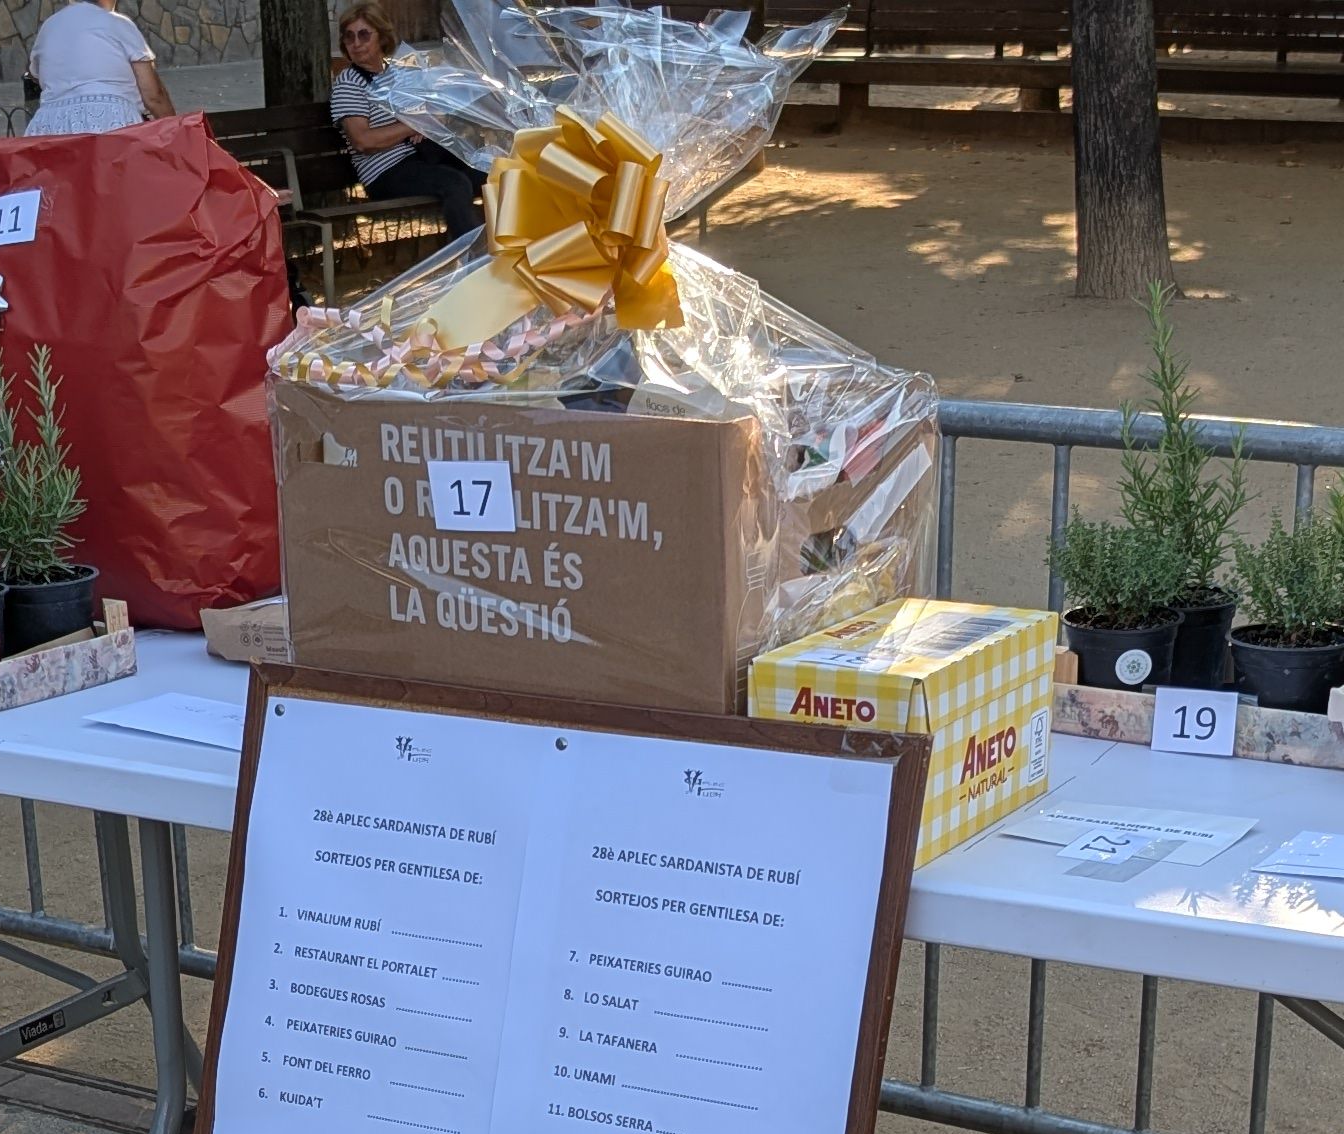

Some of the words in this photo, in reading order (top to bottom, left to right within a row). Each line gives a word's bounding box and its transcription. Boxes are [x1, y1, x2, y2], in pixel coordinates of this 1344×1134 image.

[381, 423, 611, 483] REUTILITZA'M
[384, 477, 404, 515] O
[449, 479, 492, 517] 17
[388, 533, 532, 585] AQUESTA
[544, 542, 583, 591] ÉS
[390, 585, 426, 624] LA
[436, 587, 571, 643] QÜESTIÓ
[789, 687, 876, 723] ANETO
[1172, 705, 1217, 741] 19
[960, 726, 1017, 785] ANETO
[967, 773, 1007, 803] NATURAL
[313, 808, 333, 823] 28è
[336, 812, 370, 829] APLEC
[373, 816, 446, 839] SARDANISTA
[450, 827, 465, 841] DE
[468, 829, 496, 846] RUBÍ
[315, 849, 371, 869] SORTEJOS
[374, 858, 395, 873] PER
[399, 861, 460, 883] GENTILESA
[464, 870, 483, 885] DE:
[592, 845, 614, 861] 28è
[617, 849, 657, 867] APLEC
[660, 855, 743, 879] SARDANISTA
[747, 866, 764, 882] DE
[768, 869, 801, 886] RUBÍ
[279, 906, 287, 918] 1.
[297, 908, 351, 928] VINALIUM
[354, 917, 381, 933] RUBÍ
[595, 888, 658, 910] SORTEJOS
[662, 898, 686, 914] PER
[689, 902, 759, 925] GENTILESA
[763, 912, 785, 928] DE:
[274, 942, 283, 955] 2.
[295, 945, 364, 968] RESTAURANT
[367, 957, 378, 970] EL
[382, 959, 437, 979] PORTALET
[570, 949, 578, 963] 7.
[589, 953, 661, 976] PEIXATERIES
[664, 964, 712, 983] GUIRAO
[269, 978, 278, 991] 3.
[291, 982, 348, 1002] BODEGUES
[351, 992, 386, 1009] ROSAS
[564, 988, 573, 1001] 8.
[584, 991, 599, 1005] LO
[602, 994, 639, 1011] SALAT
[265, 1015, 274, 1027] 4.
[287, 1018, 352, 1040] PEIXATERIES
[355, 1030, 396, 1048] GUIRAO
[559, 1026, 569, 1039] 9.
[580, 1029, 593, 1044] LA
[597, 1032, 657, 1054] TAFANERA
[261, 1051, 271, 1064] 5.
[283, 1054, 312, 1070] FONT
[315, 1060, 333, 1075] DEL
[336, 1064, 371, 1081] FERRO
[554, 1064, 570, 1079] 10.
[574, 1068, 616, 1086] UNAMI
[259, 1087, 268, 1099] 6.
[548, 1102, 564, 1117] 11.
[568, 1106, 612, 1125] BOLSOS
[615, 1114, 653, 1133] SERRA
